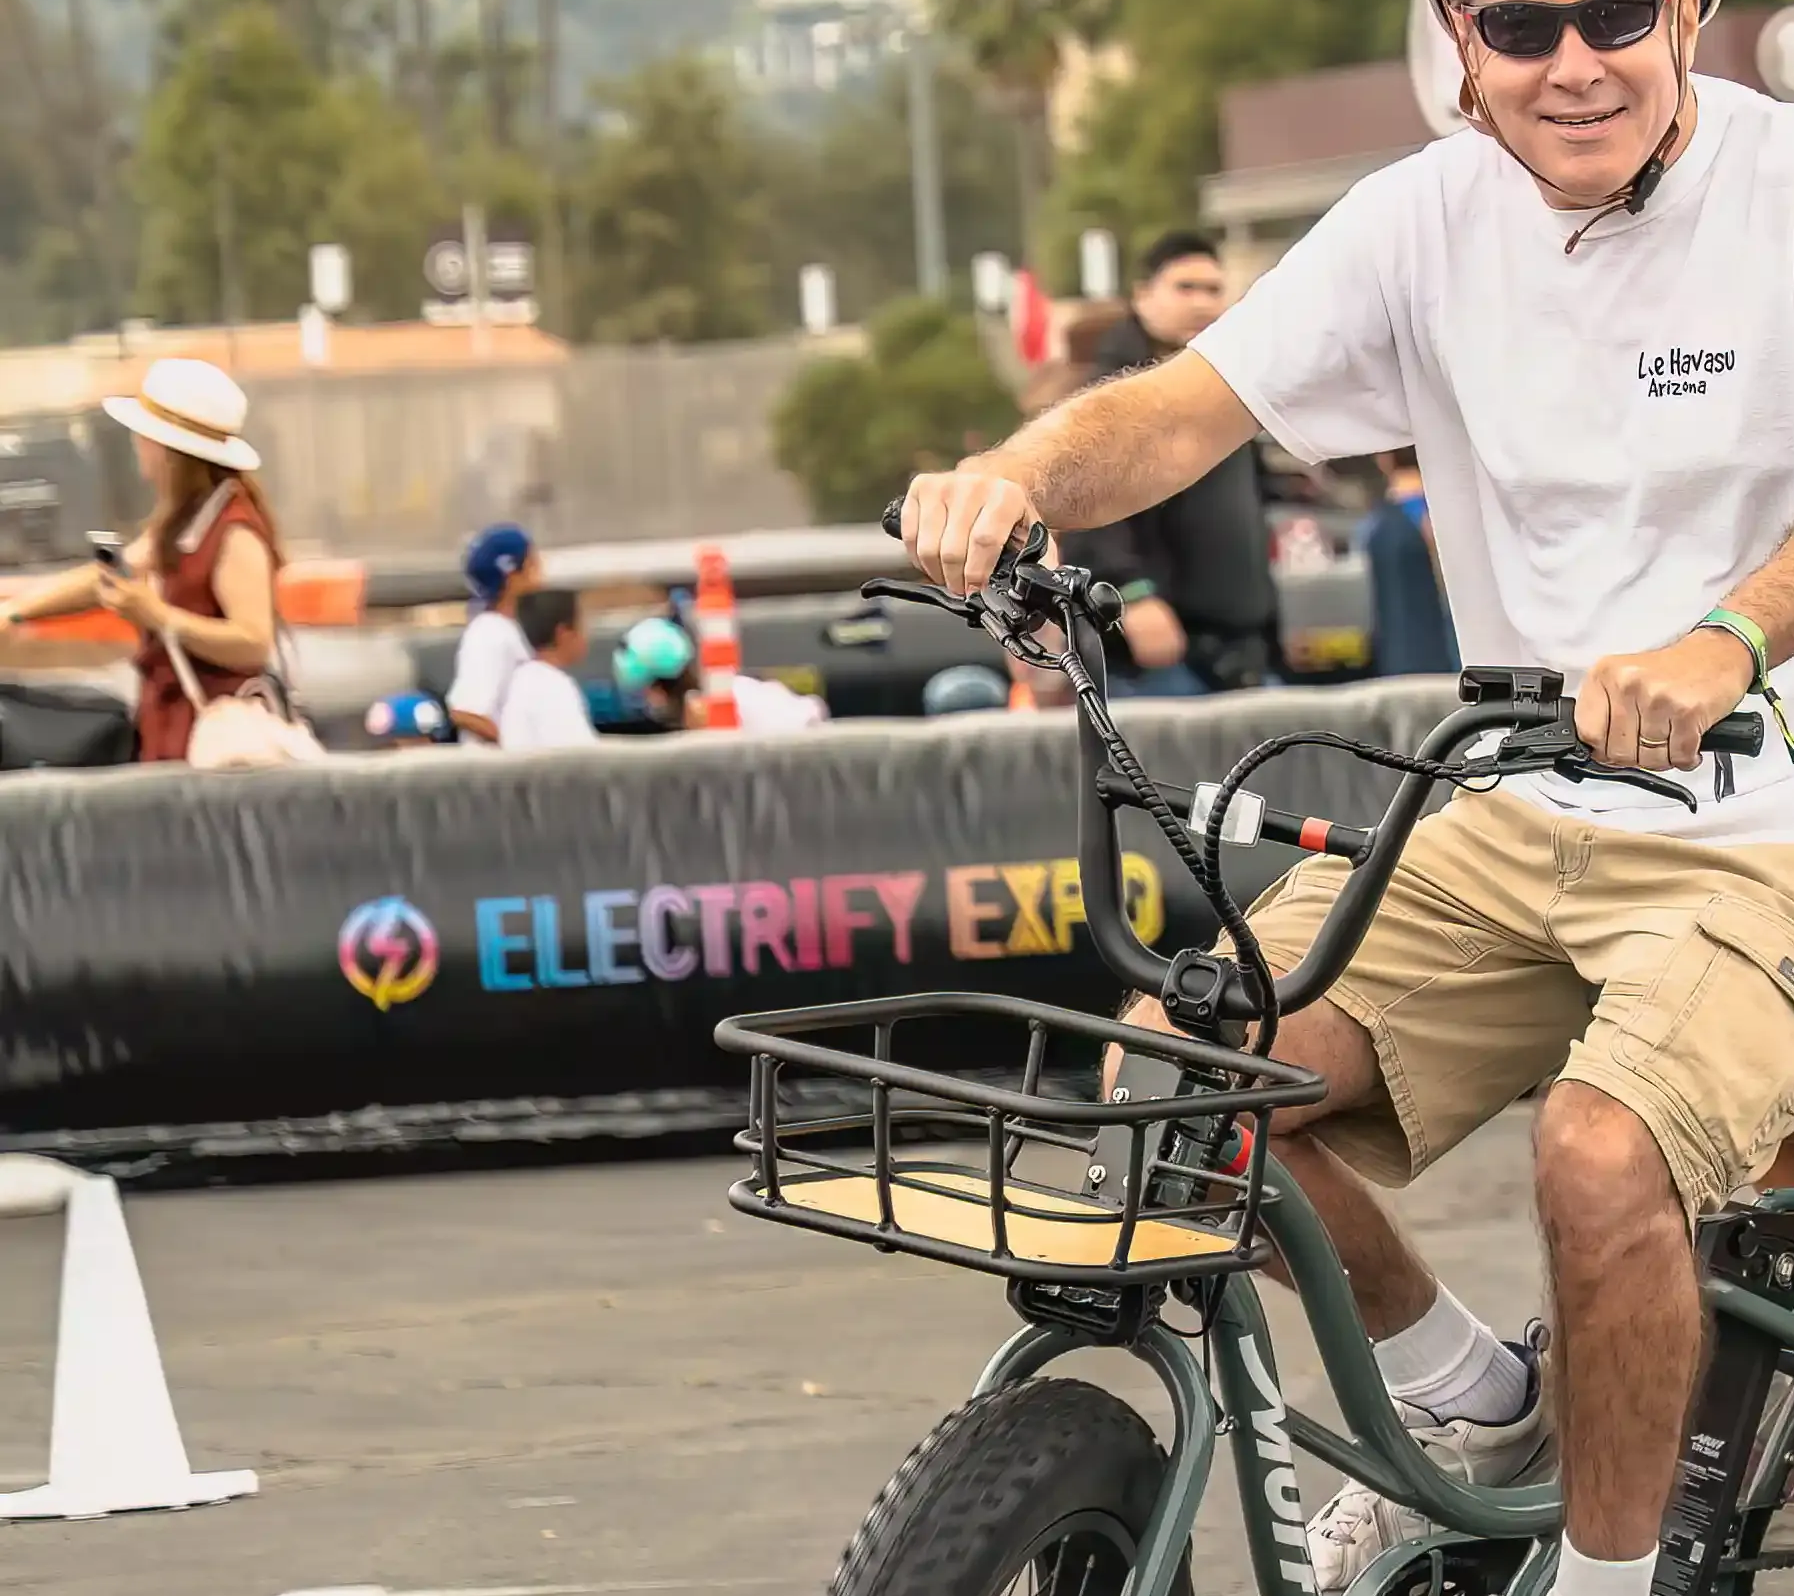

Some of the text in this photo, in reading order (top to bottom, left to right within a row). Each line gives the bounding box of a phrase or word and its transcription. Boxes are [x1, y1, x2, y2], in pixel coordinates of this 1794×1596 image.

[1669, 347, 1736, 377] Havasu
[1647, 377, 1708, 398] Arizona
[475, 851, 1166, 992] ELECTRIFY EXPO
